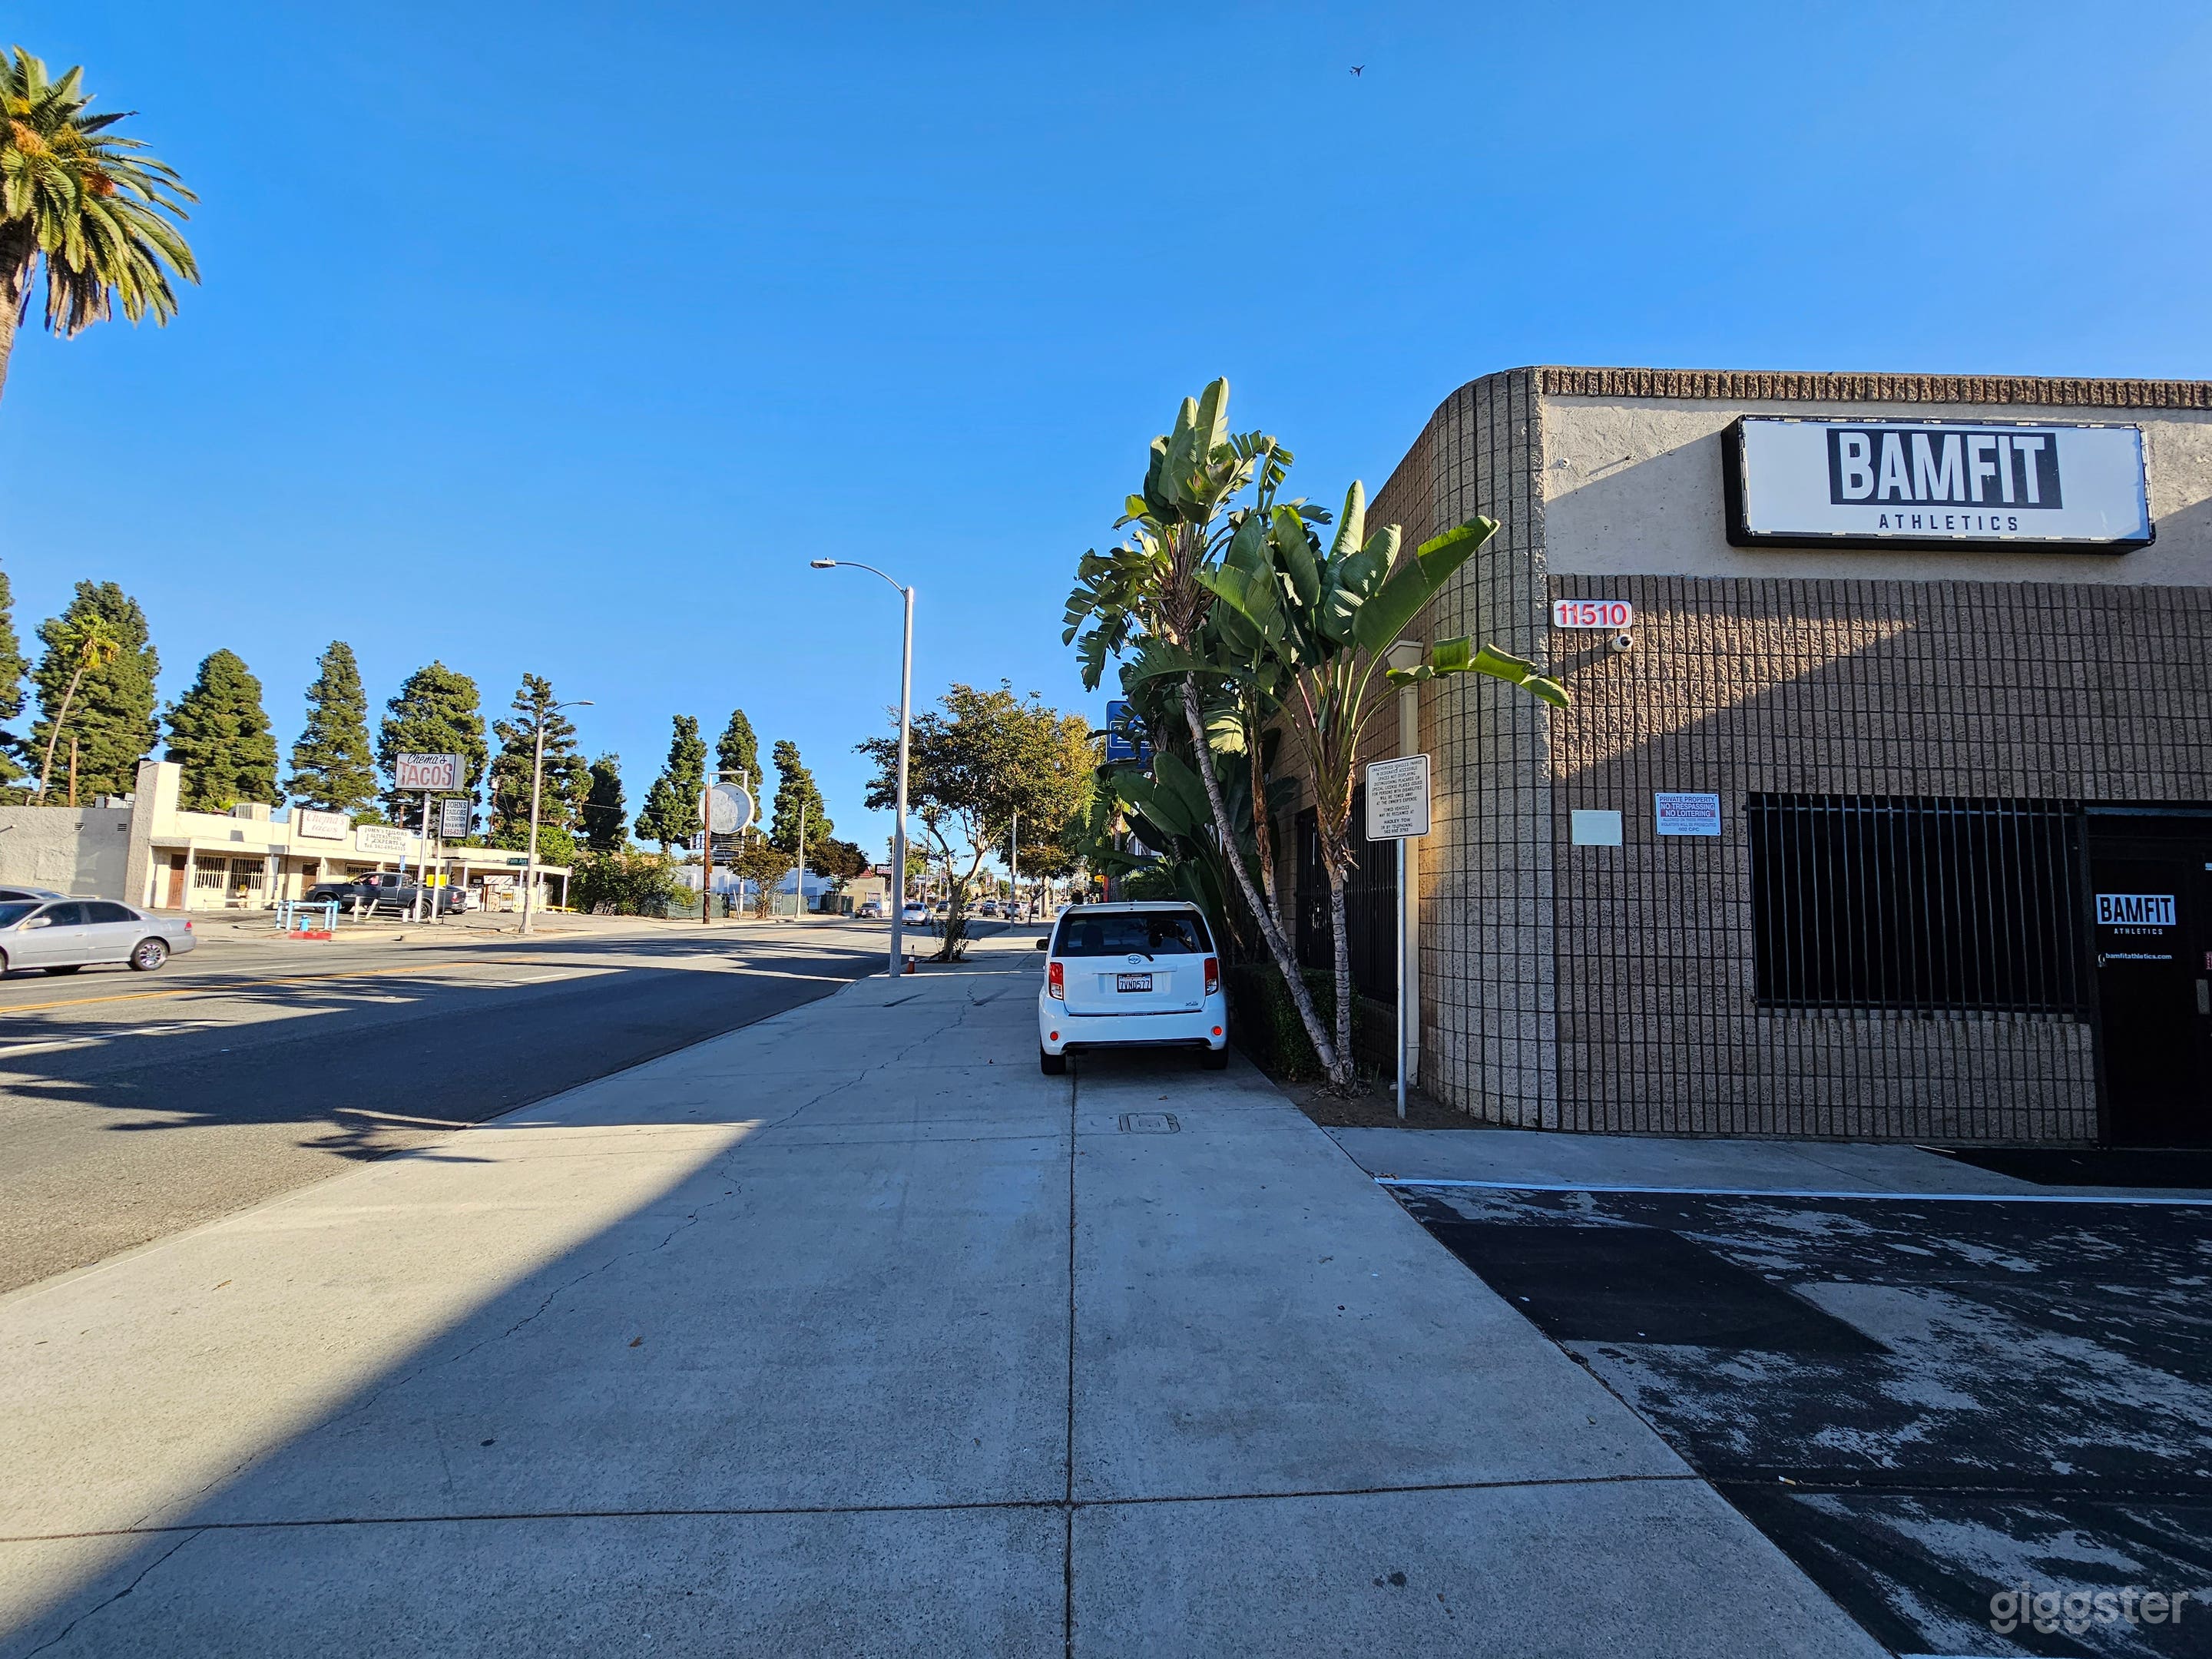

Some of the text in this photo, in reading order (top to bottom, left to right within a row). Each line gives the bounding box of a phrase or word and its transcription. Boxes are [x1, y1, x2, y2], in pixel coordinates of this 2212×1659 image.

[1839, 432, 2044, 503] BAMFIT
[1879, 514, 2018, 531] ATHLETICS
[1558, 604, 1628, 625] 11510
[408, 753, 447, 764] Chema's
[399, 761, 452, 786] TACOS
[2100, 897, 2171, 922] BAMFIT
[1120, 980, 1149, 989] 7VND577
